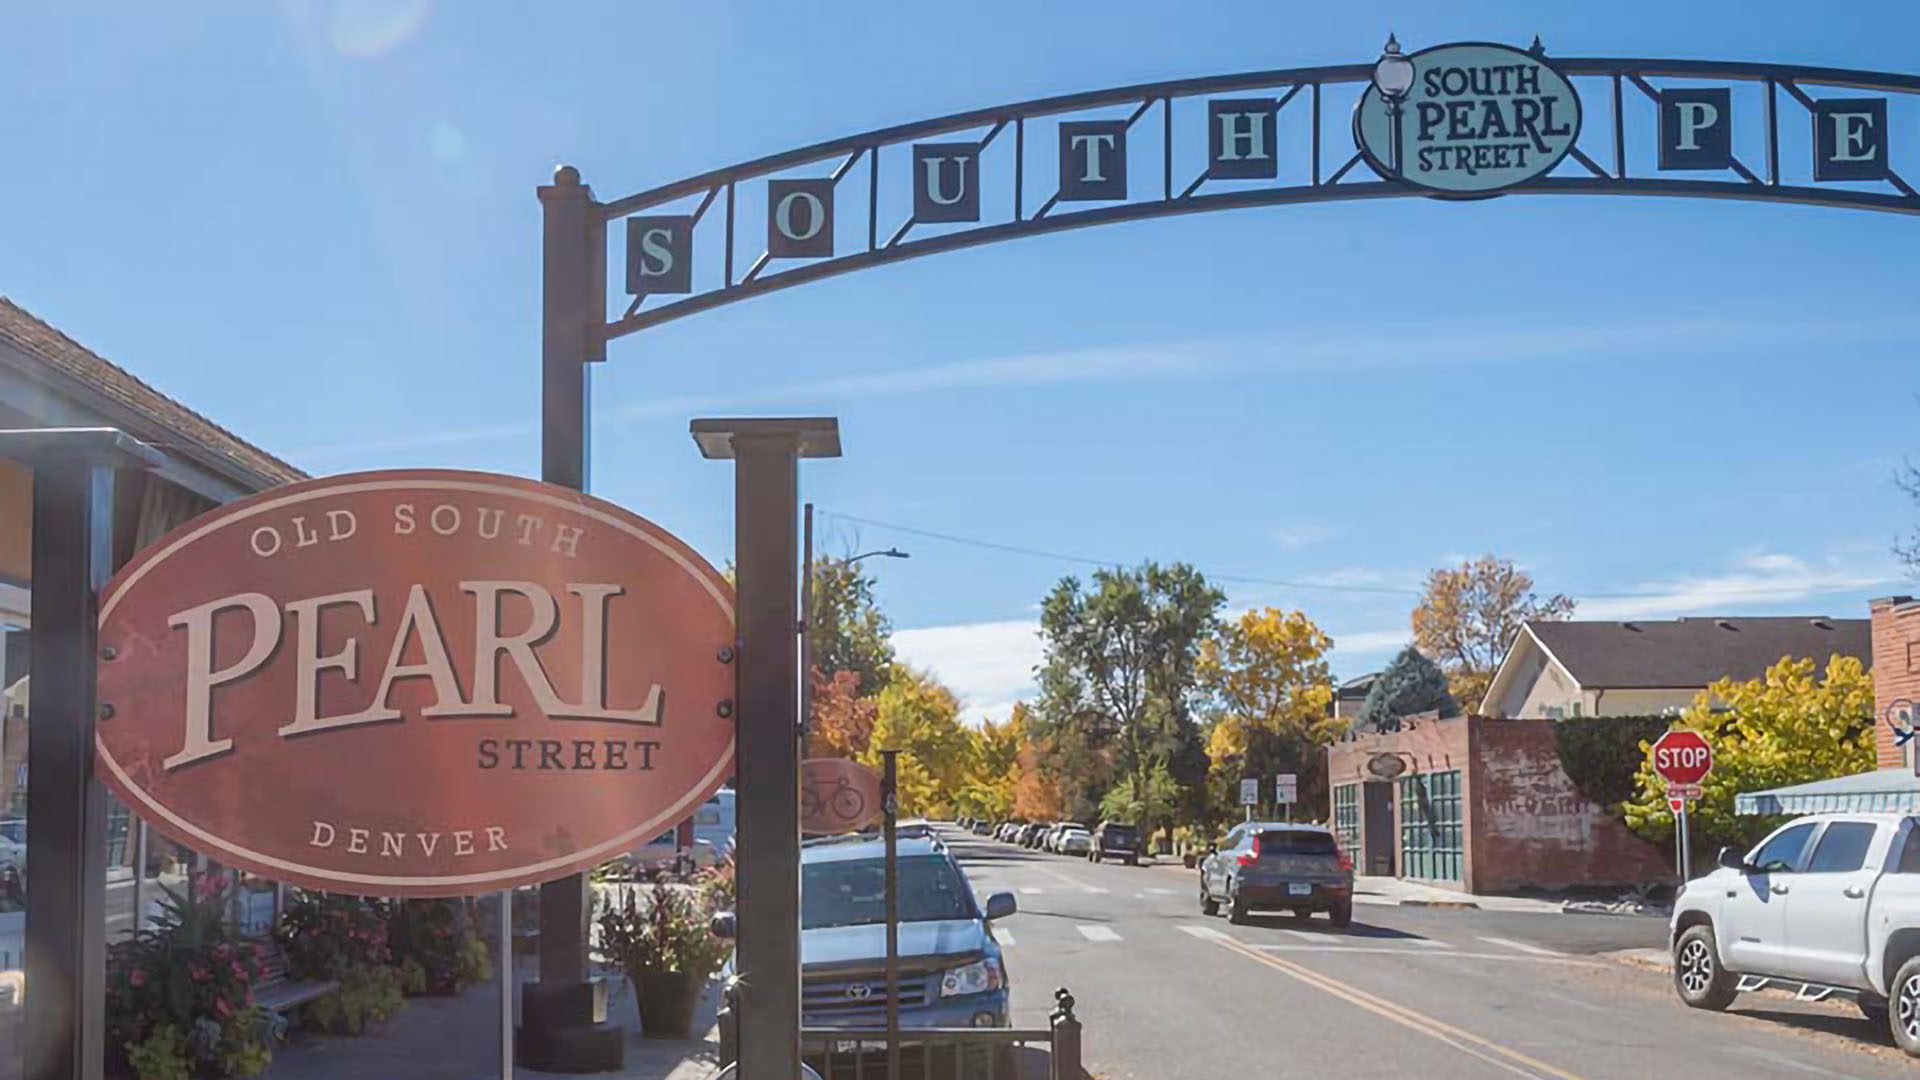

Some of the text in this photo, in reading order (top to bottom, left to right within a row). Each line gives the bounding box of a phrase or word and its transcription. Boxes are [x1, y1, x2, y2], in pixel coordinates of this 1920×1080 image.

[1424, 65, 1541, 97] SOUTH
[1417, 96, 1571, 153] PEARL
[1418, 144, 1530, 175] STREET
[250, 504, 585, 558] OLD SOUTH
[163, 580, 664, 771] PEARL
[477, 740, 661, 770] STREET
[1658, 747, 1707, 768] STOP
[310, 821, 509, 855] DENVER
